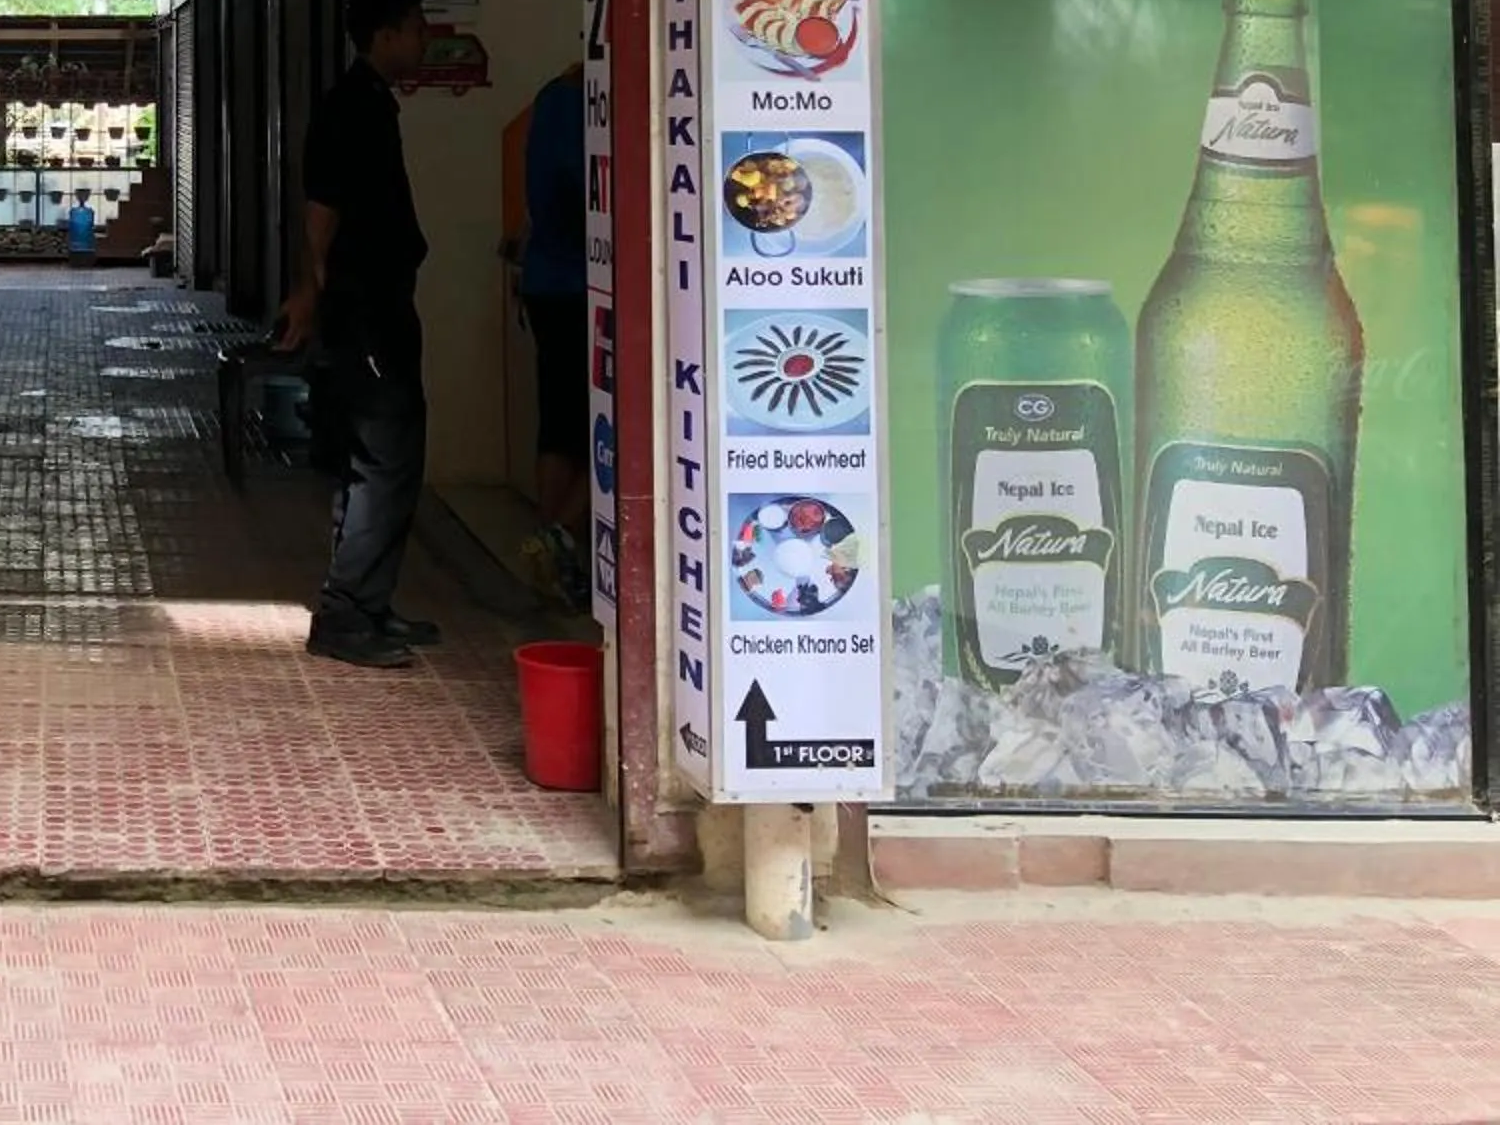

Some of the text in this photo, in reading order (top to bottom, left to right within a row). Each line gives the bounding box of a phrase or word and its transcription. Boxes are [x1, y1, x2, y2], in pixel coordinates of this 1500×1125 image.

[752, 92, 832, 111] Mo:Mo
[725, 266, 863, 287] Aloo Sukuti
[1017, 399, 1050, 415] CG
[985, 425, 1085, 446] Truly Natural
[727, 449, 866, 470] Fried Buckwheat
[1193, 457, 1283, 476] Truly Natural
[998, 480, 1075, 502] Nepal Ice
[675, 359, 703, 692] KITCHEN
[1194, 515, 1278, 540] Nepal Ice
[977, 525, 1088, 560] Natura
[1167, 567, 1288, 606] Natura
[1189, 623, 1274, 644] Nepal's First
[730, 634, 875, 655] Chicken Khana Set
[1249, 645, 1282, 660] Beer
[799, 745, 864, 762] FLOOR
